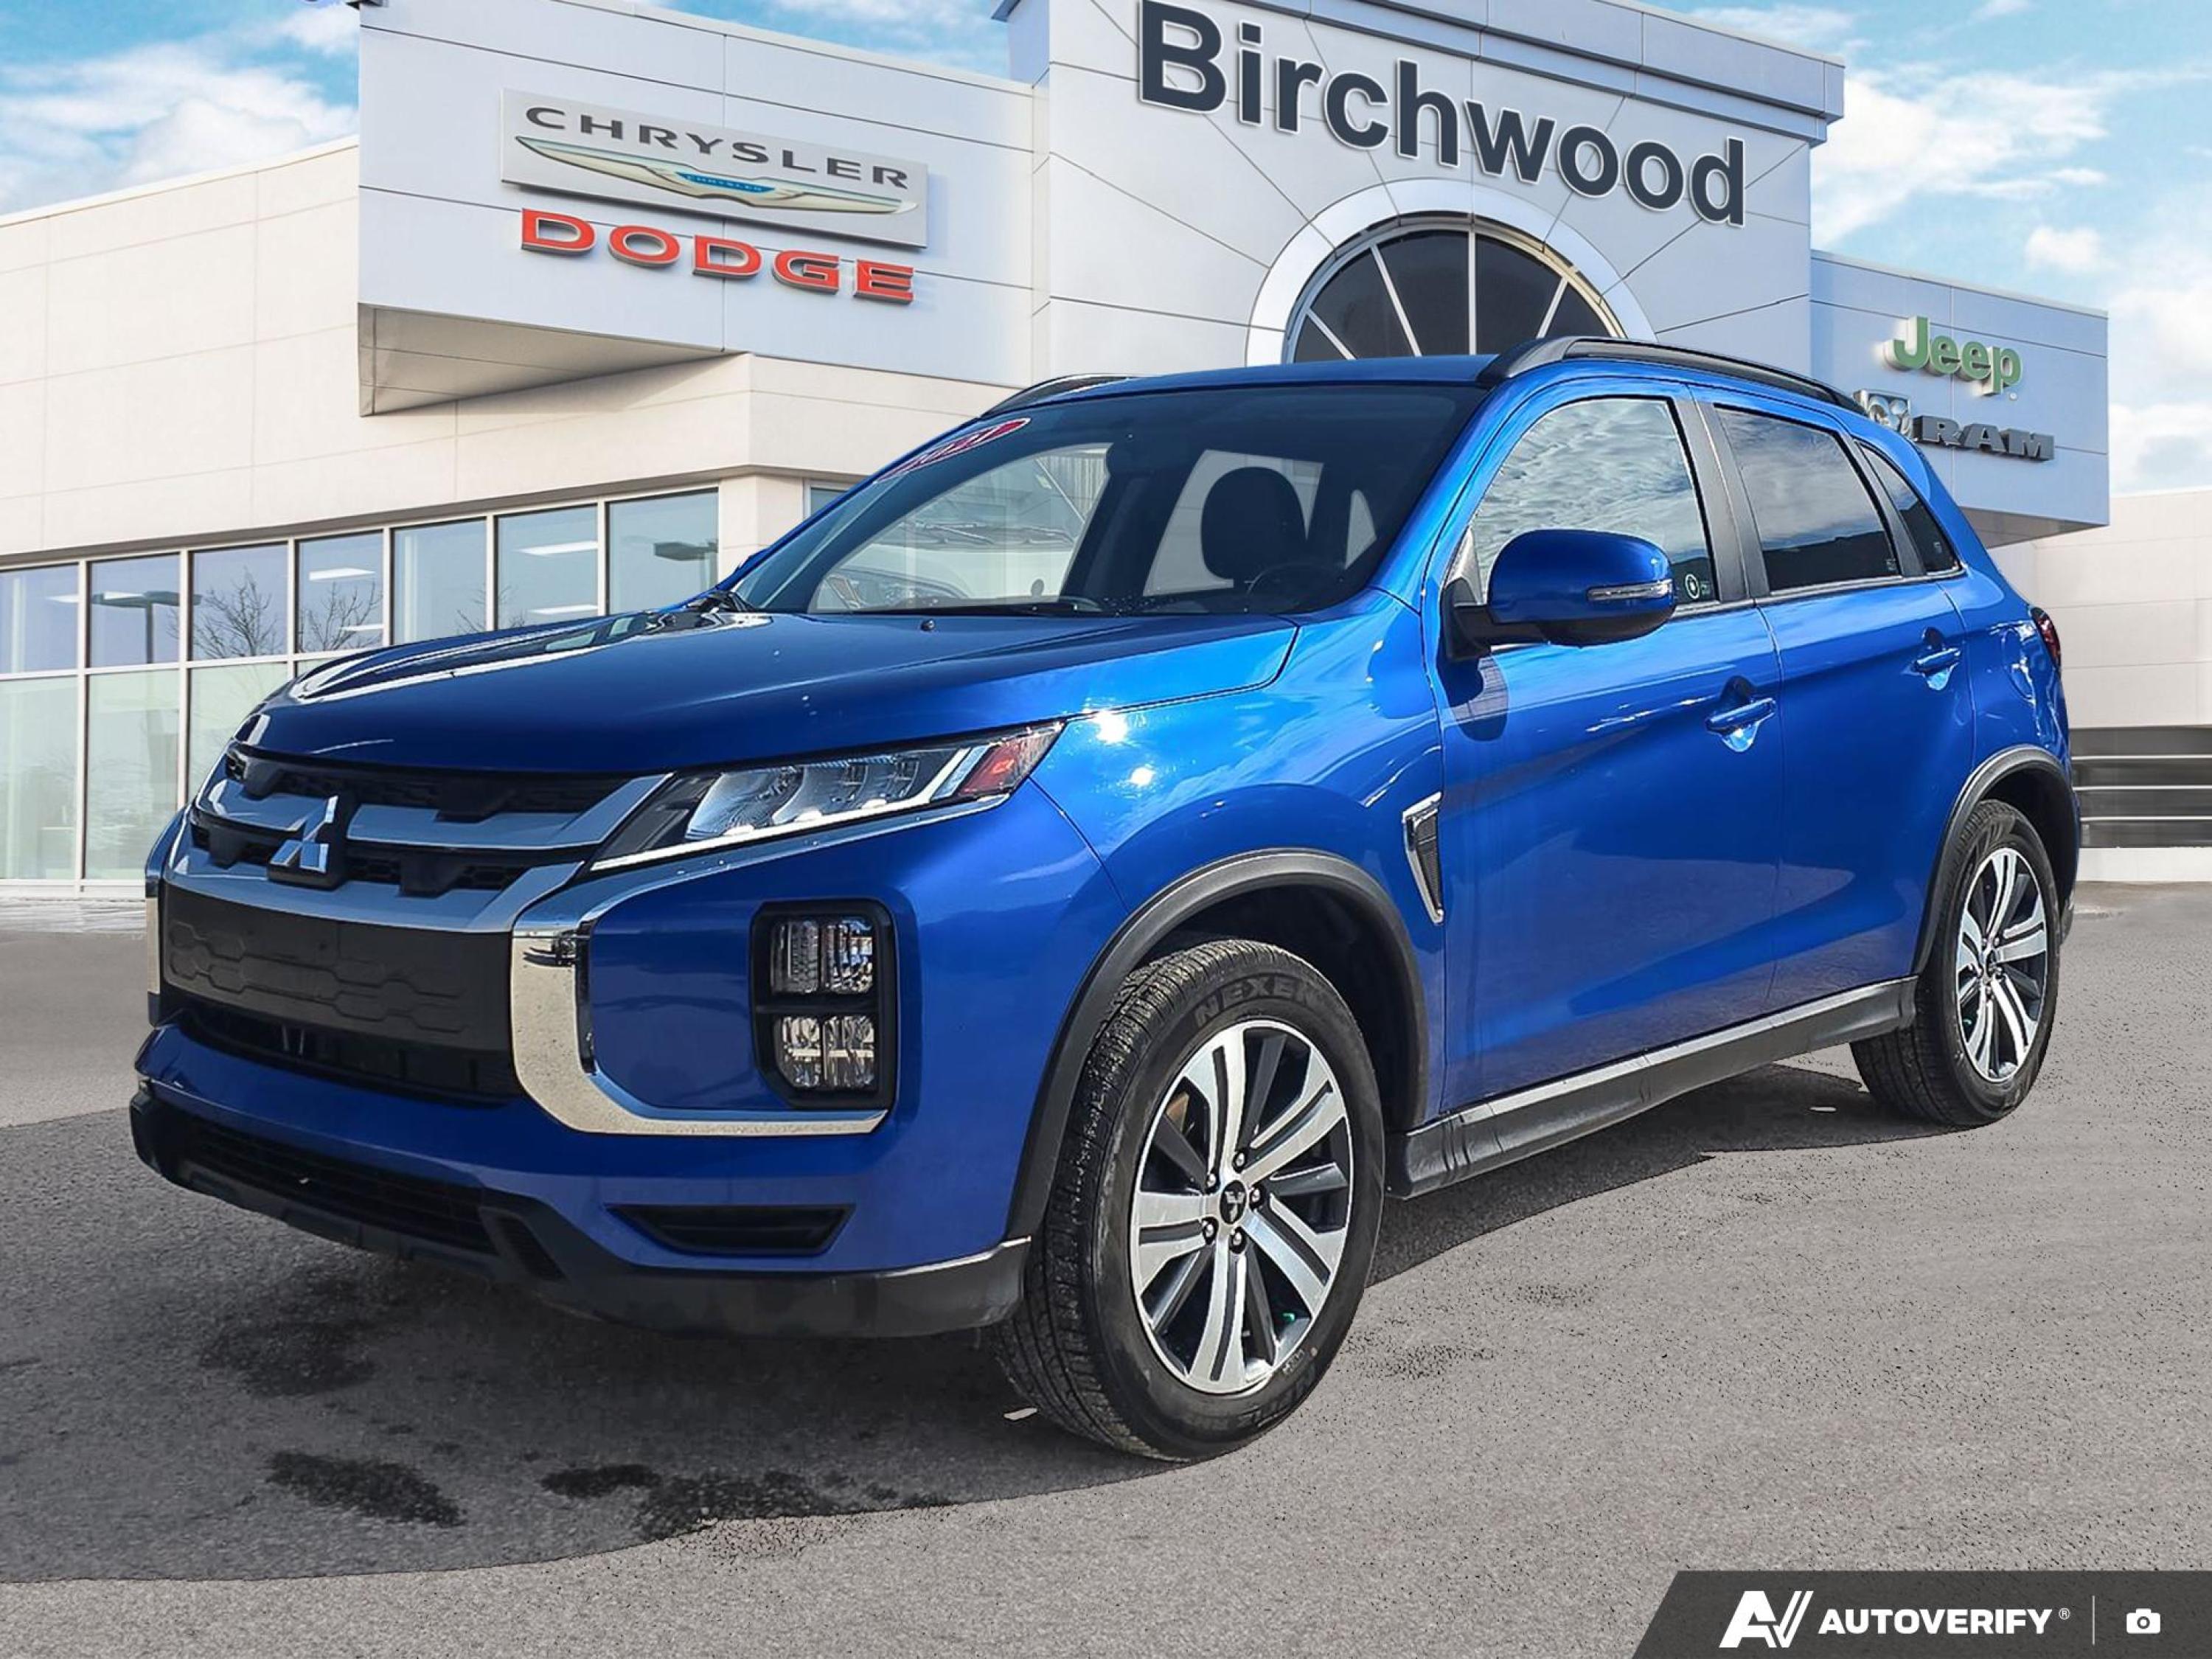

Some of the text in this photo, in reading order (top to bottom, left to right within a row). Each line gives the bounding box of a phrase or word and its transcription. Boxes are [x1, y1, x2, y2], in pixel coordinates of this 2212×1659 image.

[525, 106, 908, 189] CHRYSLER
[1141, 0, 1745, 227] Birchwood
[521, 208, 914, 304] DODGE
[1884, 316, 2023, 395] Jeep
[1913, 415, 2055, 461] RAM
